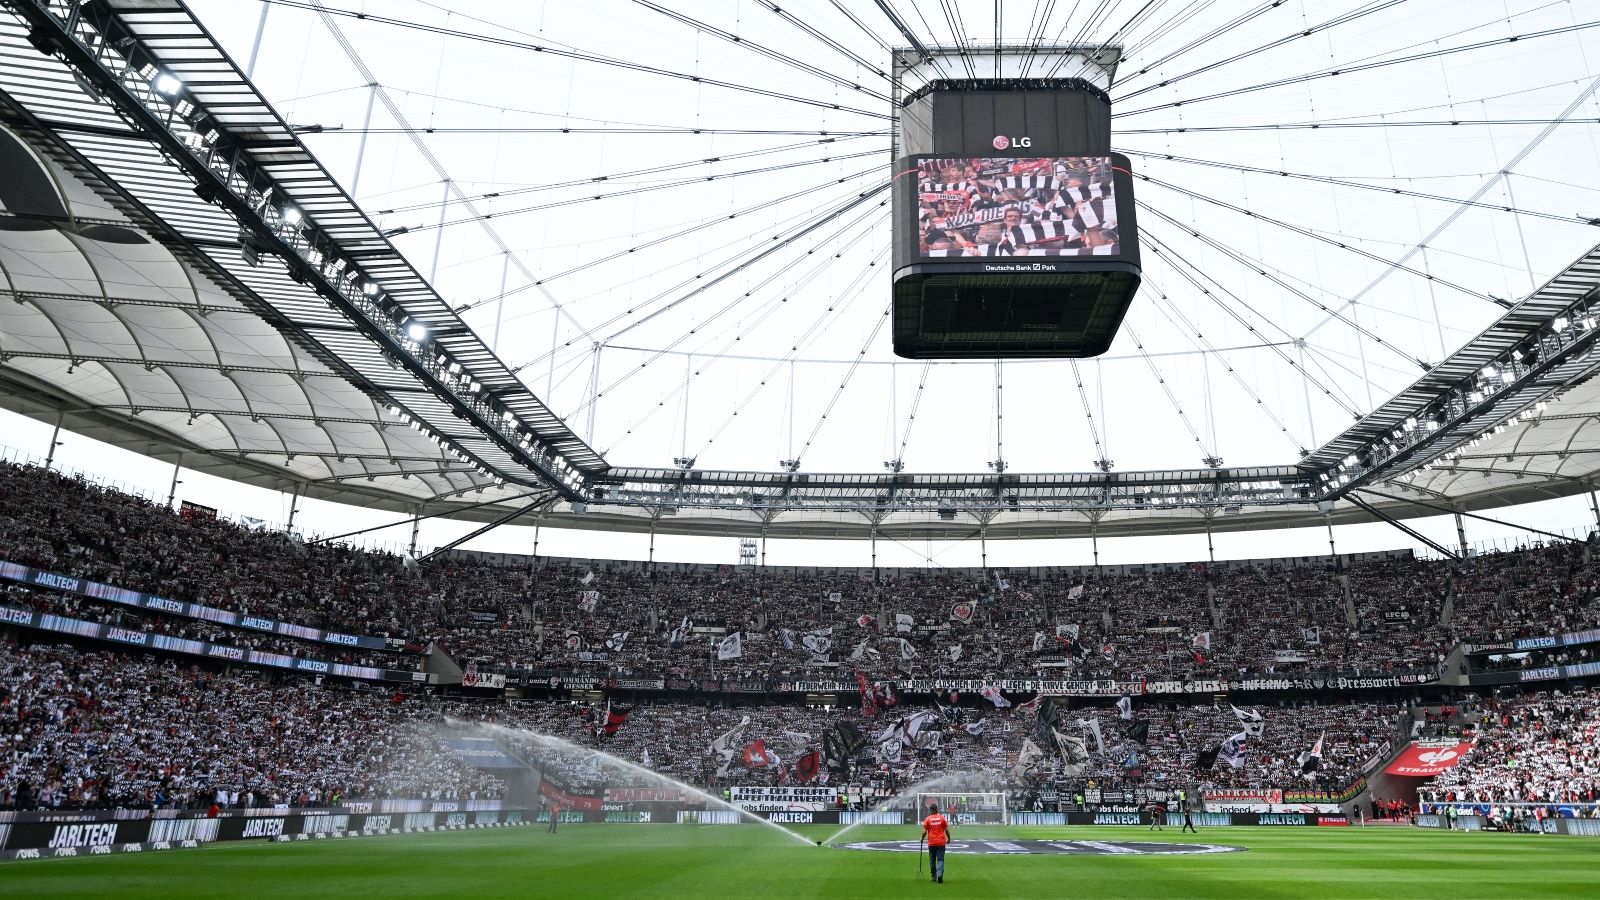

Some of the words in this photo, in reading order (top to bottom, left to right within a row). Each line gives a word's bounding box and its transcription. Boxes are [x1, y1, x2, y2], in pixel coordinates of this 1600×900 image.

[1012, 137, 1031, 148] LG
[1042, 264, 1056, 272] Park
[35, 572, 78, 591] JARLTECH
[146, 597, 183, 613] JARLTECH
[241, 616, 273, 630] JARLTECH
[106, 628, 146, 645] JARLTECH
[325, 633, 357, 646] JARLTECH
[1518, 637, 1555, 651] JARLTECH
[208, 646, 243, 660] JARLTECH
[297, 660, 327, 673] JARLTECH
[1521, 670, 1559, 682] JARLTECH
[799, 682, 835, 690] FEUERWEHR
[1242, 680, 1289, 690] INFERNO
[1337, 677, 1400, 689] Presswerk
[733, 795, 836, 803] AUFENTHALTSVERBOT
[1205, 791, 1271, 799] EINTRACHT
[432, 803, 458, 812] JARLTECH
[605, 812, 651, 822] JARLTECH
[766, 812, 812, 823] JARLTECH
[1094, 814, 1140, 824] JARLTECH
[1258, 815, 1305, 825] JARLTECH
[243, 819, 284, 838] JARLTECH
[365, 816, 391, 832] JARLTECH
[49, 824, 118, 848] JARLTECH
[94, 846, 111, 854] DWS
[126, 843, 141, 851] DWS
[156, 842, 170, 850] DWS
[21, 849, 39, 858] DWS
[59, 848, 76, 856] DWS
